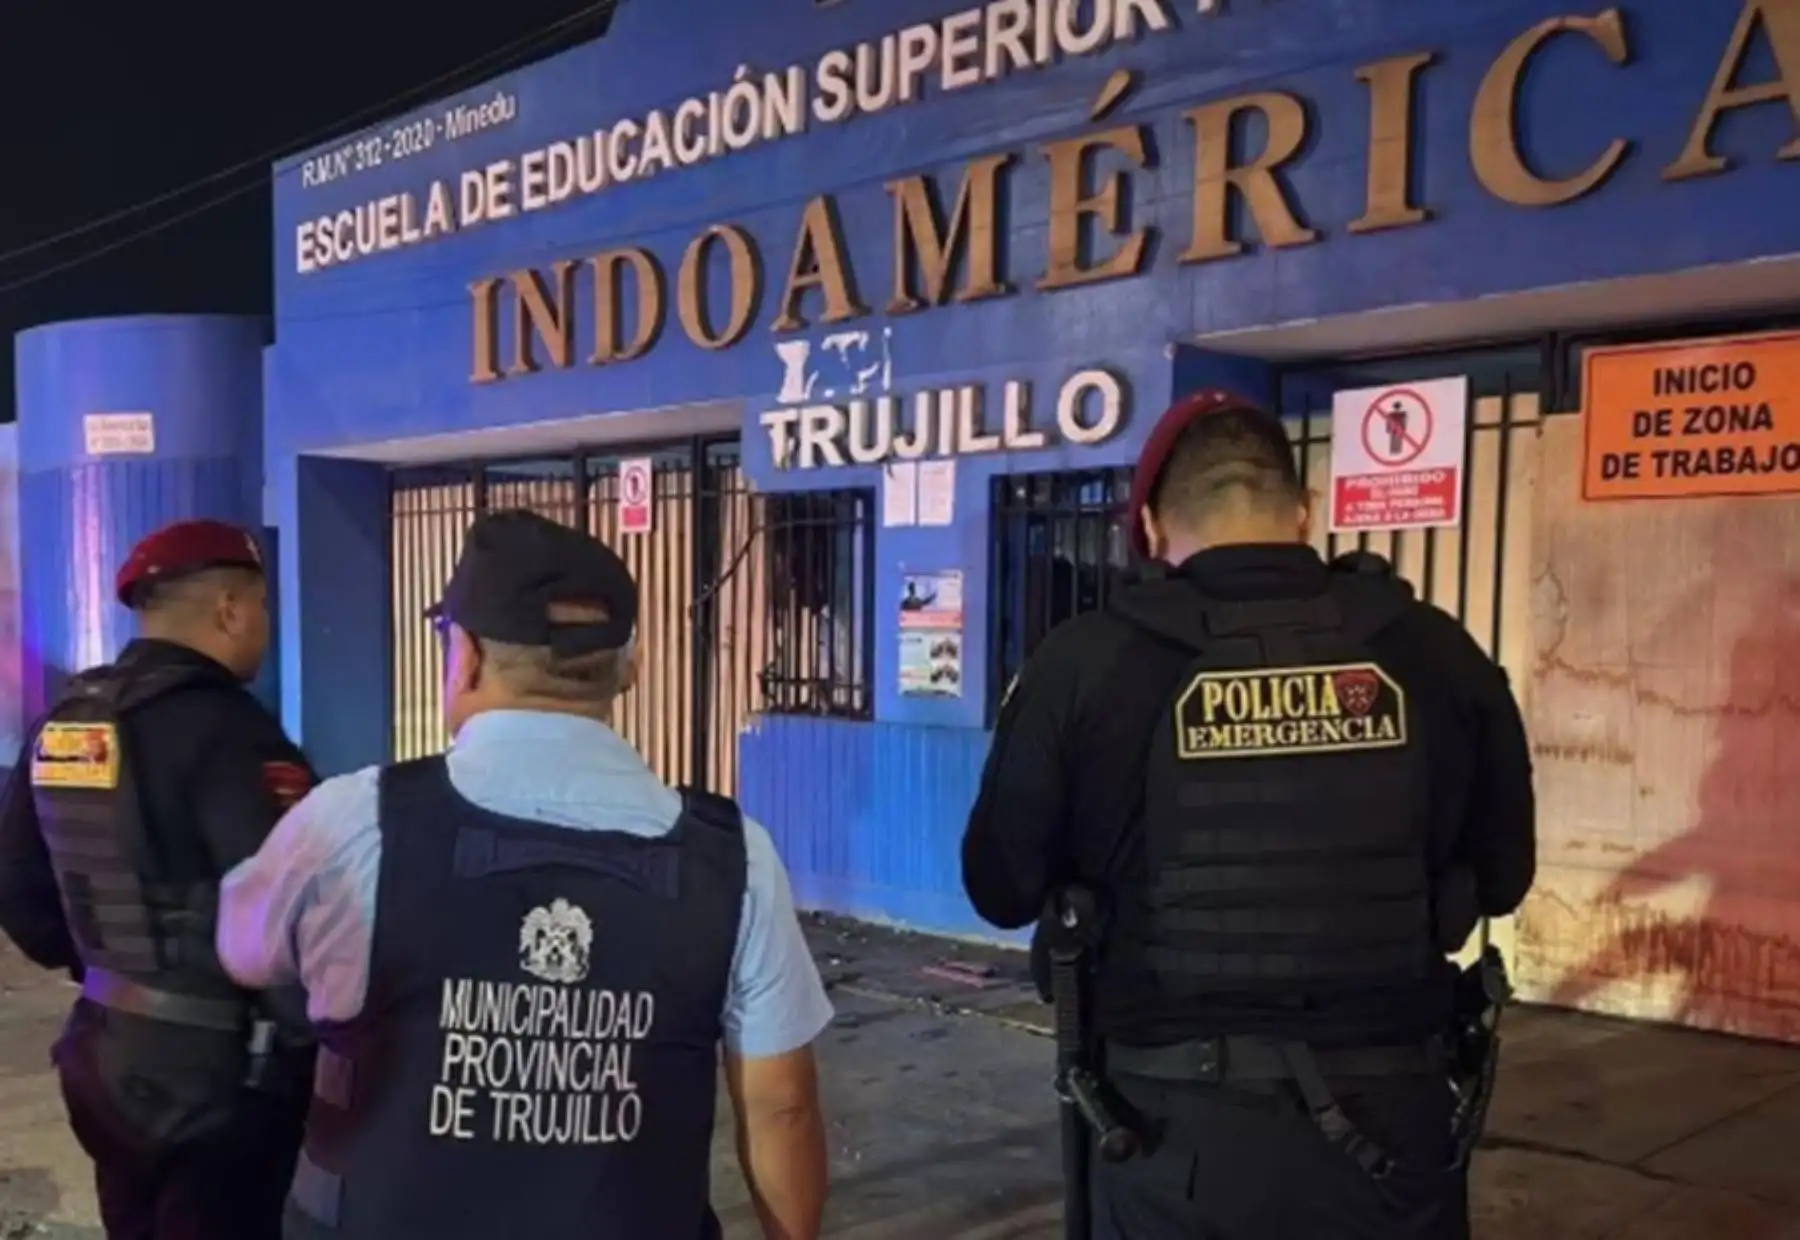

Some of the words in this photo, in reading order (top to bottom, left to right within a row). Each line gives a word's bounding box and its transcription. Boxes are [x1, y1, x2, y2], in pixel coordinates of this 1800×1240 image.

[445, 91, 516, 140] Minedu
[296, 180, 453, 273] ESCUELA
[461, 159, 517, 227] DE
[521, 64, 806, 212] EDUCACIÓN
[467, 0, 1800, 384] INDOAMÉRICA
[1653, 361, 1756, 396] INICIO
[760, 369, 1124, 470] TRUJILLO
[1633, 408, 1674, 438] DE
[1682, 402, 1774, 434] ZONA
[1602, 452, 1640, 480] DE
[1651, 443, 1800, 479] TRABAJO
[1202, 674, 1340, 722] POLICIA
[1188, 714, 1396, 749] EMERGENCIA
[440, 977, 654, 1039] MUNICIPALIDAD
[442, 1032, 637, 1091] PROVINCIAL
[430, 1084, 475, 1138] DE
[489, 1092, 642, 1144] TRUJILLO
